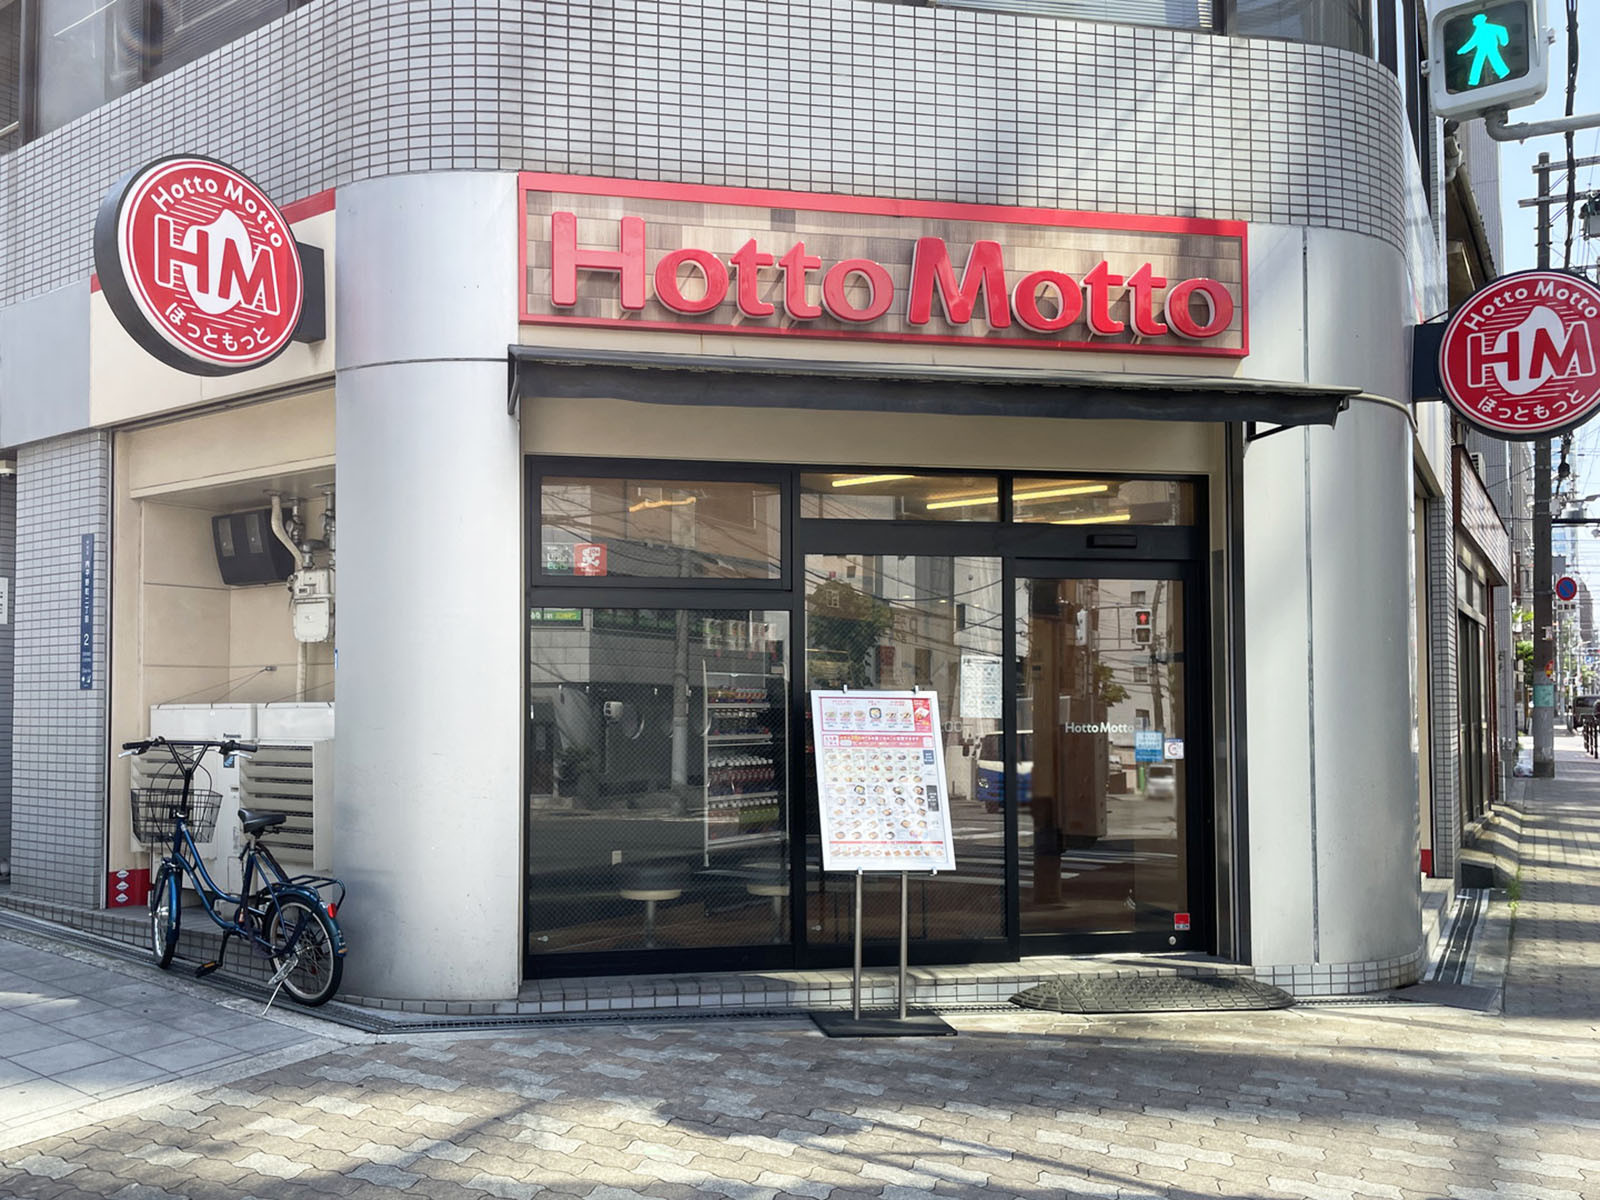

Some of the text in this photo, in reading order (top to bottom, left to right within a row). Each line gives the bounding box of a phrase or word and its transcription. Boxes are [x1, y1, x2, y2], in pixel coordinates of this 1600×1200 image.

[150, 174, 283, 249] Hotto Motto
[551, 211, 1234, 340] Hotto Motto
[165, 303, 271, 352] ほっともっと
[1464, 281, 1598, 331] Hotto Motto
[1477, 390, 1586, 422] ほっともっと
[83, 633, 89, 646] 2
[1065, 721, 1135, 734] Hotto Motto
